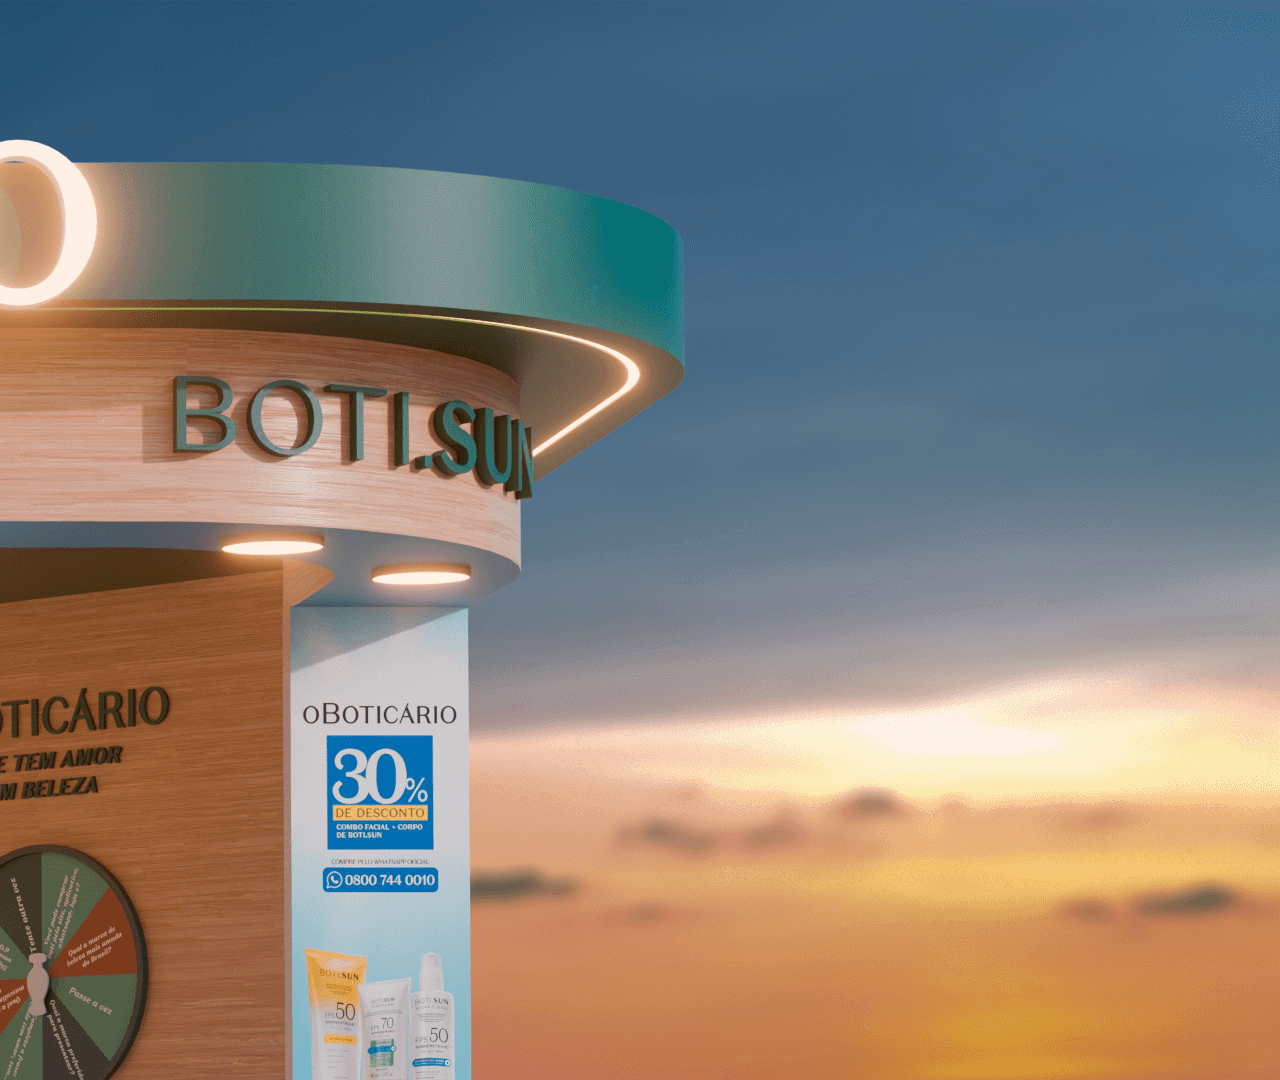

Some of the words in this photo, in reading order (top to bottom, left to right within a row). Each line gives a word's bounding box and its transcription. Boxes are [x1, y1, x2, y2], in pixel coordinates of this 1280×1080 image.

[173, 375, 534, 500] BOTI.SUN
[13, 752, 56, 772] TEM
[60, 746, 123, 768] AMOR
[21, 776, 98, 800] BELEZA
[332, 748, 428, 804] 30%
[336, 808, 351, 818] DE
[357, 808, 425, 818] DESCONTO
[10, 877, 19, 894] vez
[345, 874, 377, 886] 0800
[380, 874, 402, 886] 744
[405, 874, 435, 886] 0010
[16, 895, 28, 923] outra
[25, 925, 37, 954] Tente
[69, 986, 92, 1003] Passe
[99, 1004, 112, 1015] vez
[336, 1002, 355, 1020] 50
[381, 1017, 394, 1028] 70
[430, 1028, 448, 1043] 50
